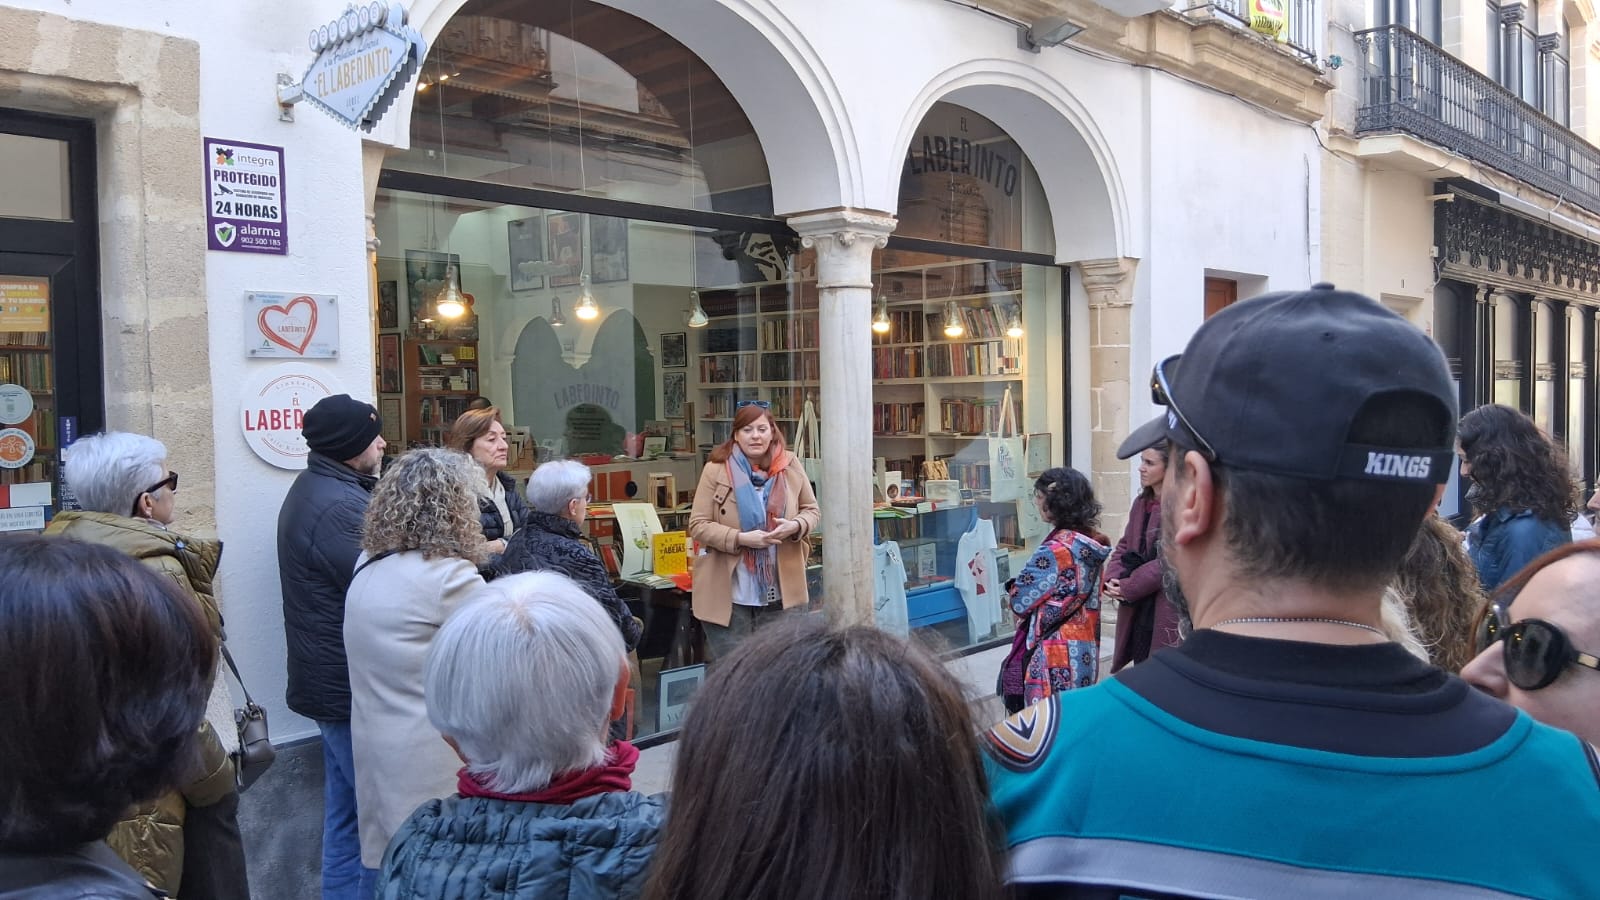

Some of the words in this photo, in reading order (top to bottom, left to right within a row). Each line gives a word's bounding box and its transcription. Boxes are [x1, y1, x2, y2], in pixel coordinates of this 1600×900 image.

[317, 71, 329, 98] EL
[330, 46, 390, 93] LABERINTO
[960, 117, 968, 132] EL
[237, 153, 274, 167] integra
[909, 135, 1017, 197] LABERINTO
[213, 169, 277, 187] PROTEGIDO
[215, 200, 232, 215] 24
[235, 202, 278, 219] HORAS
[240, 224, 281, 237] alarma
[245, 408, 304, 431] LABER
[1364, 452, 1432, 478] KINGS
